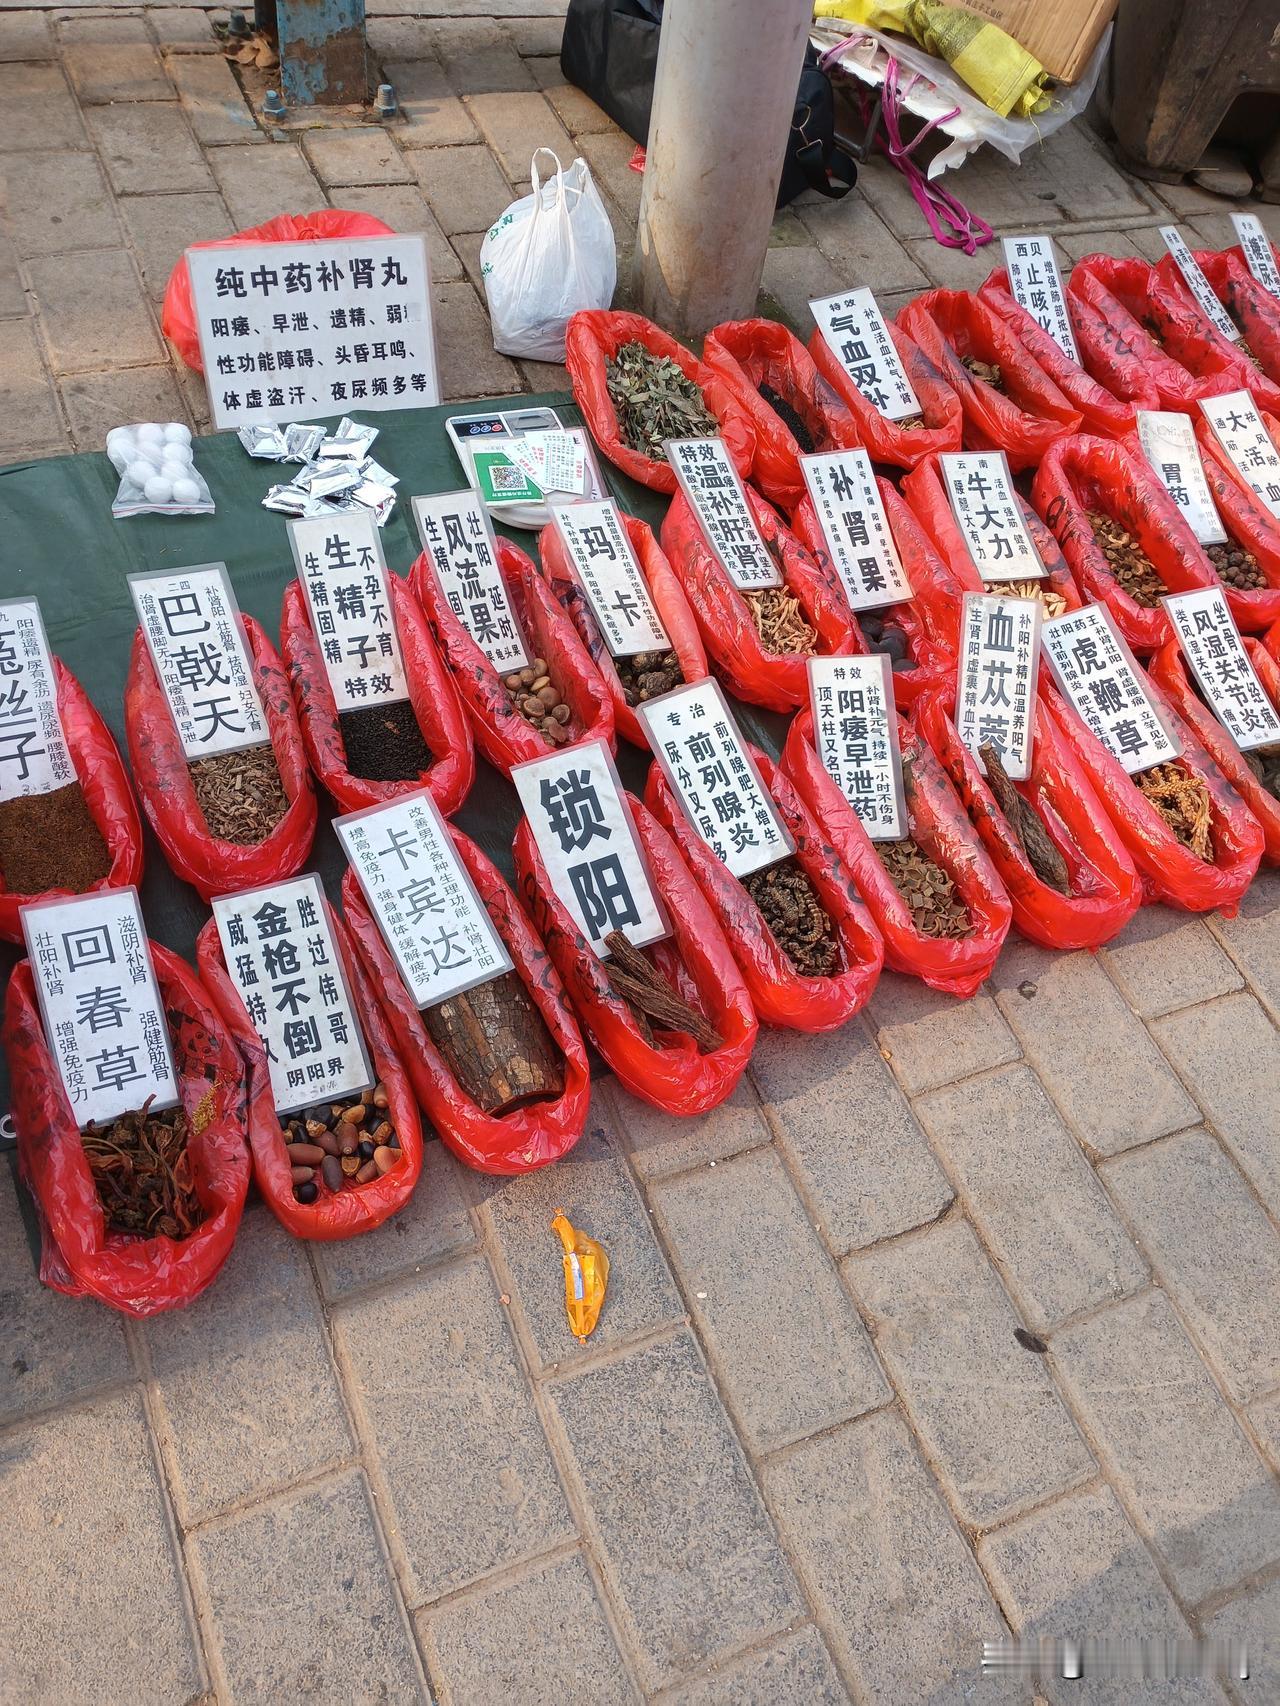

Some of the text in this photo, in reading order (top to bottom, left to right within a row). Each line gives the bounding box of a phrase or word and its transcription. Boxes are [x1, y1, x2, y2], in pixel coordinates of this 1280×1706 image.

[215, 256, 407, 297] 纯中药补肾丸
[829, 299, 856, 312] 特效
[1015, 242, 1042, 256] 西贝
[211, 303, 413, 337] 阳痿、早泄、遗精、弱
[217, 340, 417, 374] 性功能障碍、头昏耳鸣、
[830, 315, 890, 410] 气血双补
[864, 308, 911, 404] 补血活血补气补肾
[223, 373, 427, 410] 体虚盗汗、夜尿频多等
[679, 444, 717, 463] 特效
[957, 459, 988, 469] 云南
[994, 478, 1008, 500] 活血
[1162, 464, 1190, 505] 胃药
[425, 515, 451, 573] 生精
[467, 511, 515, 639] 壮阳 延时
[695, 465, 759, 568] 温补肝肾
[717, 463, 771, 568] 阳痿早泄房事不坚
[738, 569, 773, 580] 顶天柱
[829, 465, 887, 592] 补肾果
[968, 472, 1014, 559] 牛大力
[168, 581, 191, 592] 二四
[305, 552, 342, 664] 生精固精
[325, 534, 376, 669] 生精子
[357, 546, 394, 657] 不孕不育
[442, 514, 500, 644] 风流果
[579, 526, 641, 626] 玛卡
[1049, 614, 1099, 639] 壮阳药王
[17, 618, 71, 780] 阳痿遗精 尿有余沥 遗尿尿频 腰膝酸软
[139, 594, 198, 743] 治肾虚腰脚无力 阳痿遗精 早泄
[158, 593, 246, 742] 巴戟天
[205, 585, 262, 731] 补肾阳 壮筋骨 祛风湿 妇女不育
[344, 673, 394, 699] 特效
[667, 703, 706, 727] 专治
[834, 667, 862, 680] 特效
[977, 606, 1015, 762] 血苁蓉
[1011, 614, 1032, 764] 补阳补精血温养阳气
[1050, 641, 1123, 764] 对前列腺炎 肥大增生有
[1072, 637, 1148, 756] 虎鞭草
[1095, 626, 1168, 750] 补肾壮阳 肾虚腰痛 立竿见影
[1175, 609, 1246, 737] 类风湿关节炎 痛风
[1192, 610, 1264, 732] 风湿关节炎
[1213, 601, 1279, 729] 坐骨神经痛
[684, 732, 759, 853] 前列腺炎
[713, 721, 779, 844] 前列腺肥大增生
[837, 690, 877, 822] 阳痿早泄药
[866, 686, 894, 825] 补肾补元气 持续一小时不伤身
[348, 827, 385, 886] 提高免疫力
[378, 828, 472, 976] 卡宾达
[408, 806, 495, 969] 改善男性各种生理功能 补肾壮阳
[539, 769, 642, 941] 锁阳
[35, 932, 88, 1104] 壮阳补肾 增强免疫力
[62, 924, 147, 1091] 回春草
[117, 915, 170, 1080] 滋阴补肾 强健筋骨
[227, 914, 279, 1064] 威猛持久
[252, 902, 323, 1059] 金枪不倒
[296, 895, 349, 1045] 胜过伟哥
[287, 1057, 345, 1088] 阴阳界
